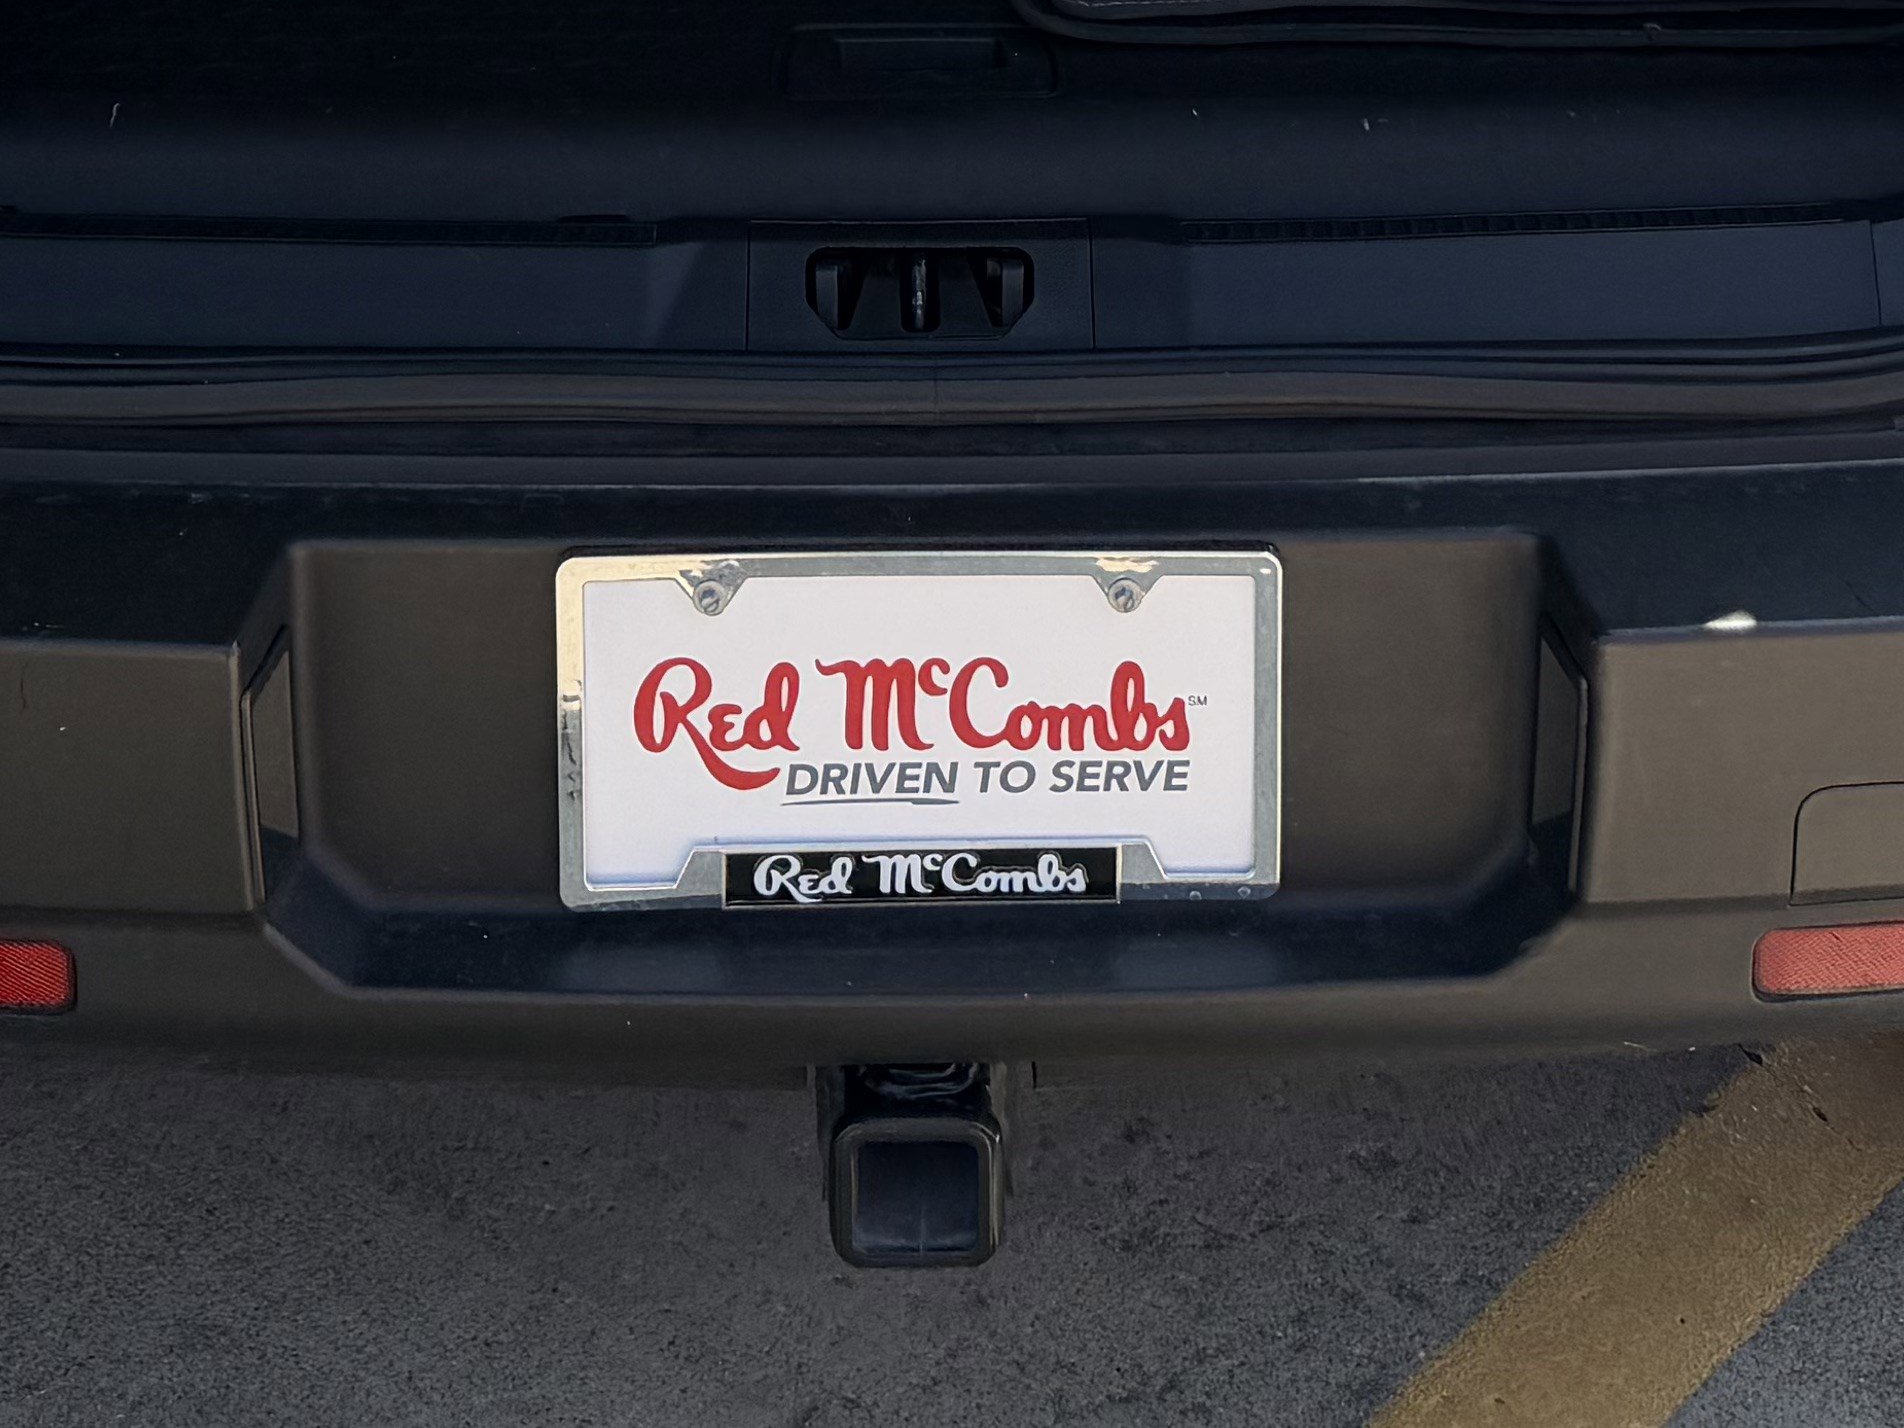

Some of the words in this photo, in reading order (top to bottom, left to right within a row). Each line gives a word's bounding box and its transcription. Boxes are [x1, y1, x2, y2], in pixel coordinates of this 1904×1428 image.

[633, 657, 800, 790] Red
[815, 657, 1190, 751] McCombs
[786, 761, 958, 795] DRIVEN
[973, 760, 1036, 793] TO
[1049, 759, 1190, 792] SERVE
[753, 854, 853, 903] Red
[861, 852, 1088, 894] McCombs
